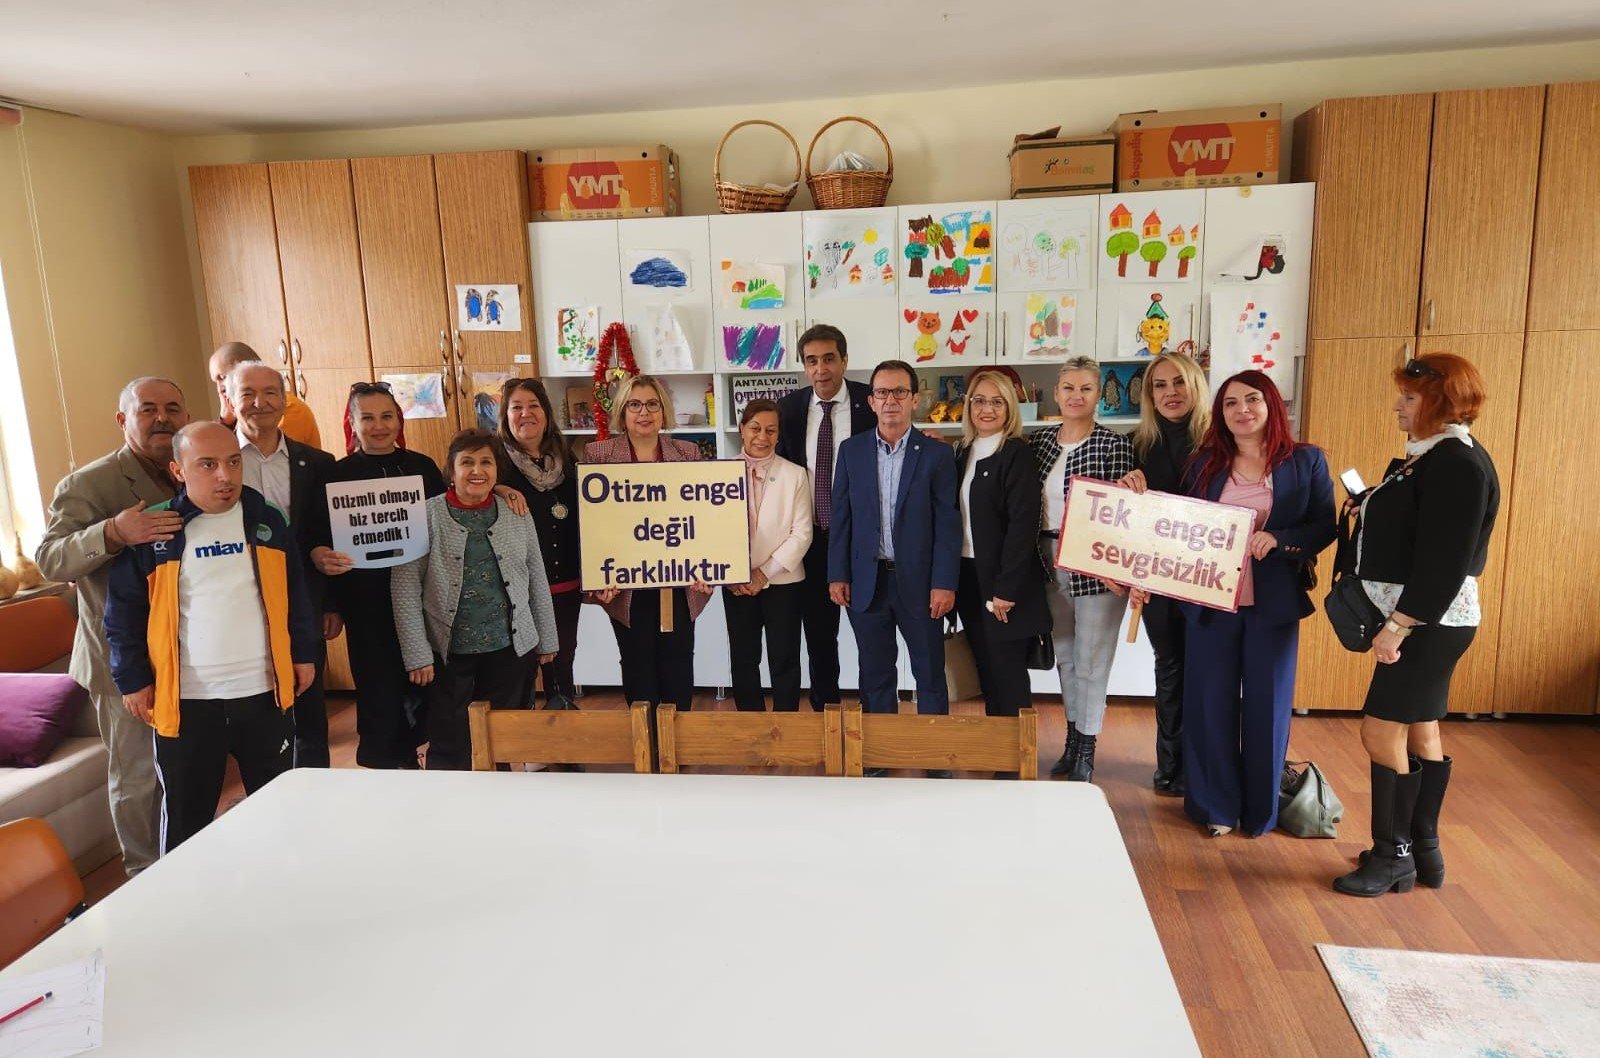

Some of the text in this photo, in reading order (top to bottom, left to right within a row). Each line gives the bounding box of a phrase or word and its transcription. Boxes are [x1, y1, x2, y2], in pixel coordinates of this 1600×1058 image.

[1170, 137, 1236, 163] YMT
[569, 174, 623, 198] YMT
[735, 377, 797, 387] ANTALYA'da
[332, 490, 420, 509] Otizmli olmayı
[581, 473, 744, 505] Otizm engel
[349, 508, 408, 527] biz tercih
[1086, 490, 1237, 551] Tek engel
[352, 527, 402, 546] etmedik
[634, 516, 694, 547] değil
[195, 541, 244, 558] miav
[600, 558, 731, 585] farklılıktır
[1091, 541, 1233, 593] sevgisizlik.
